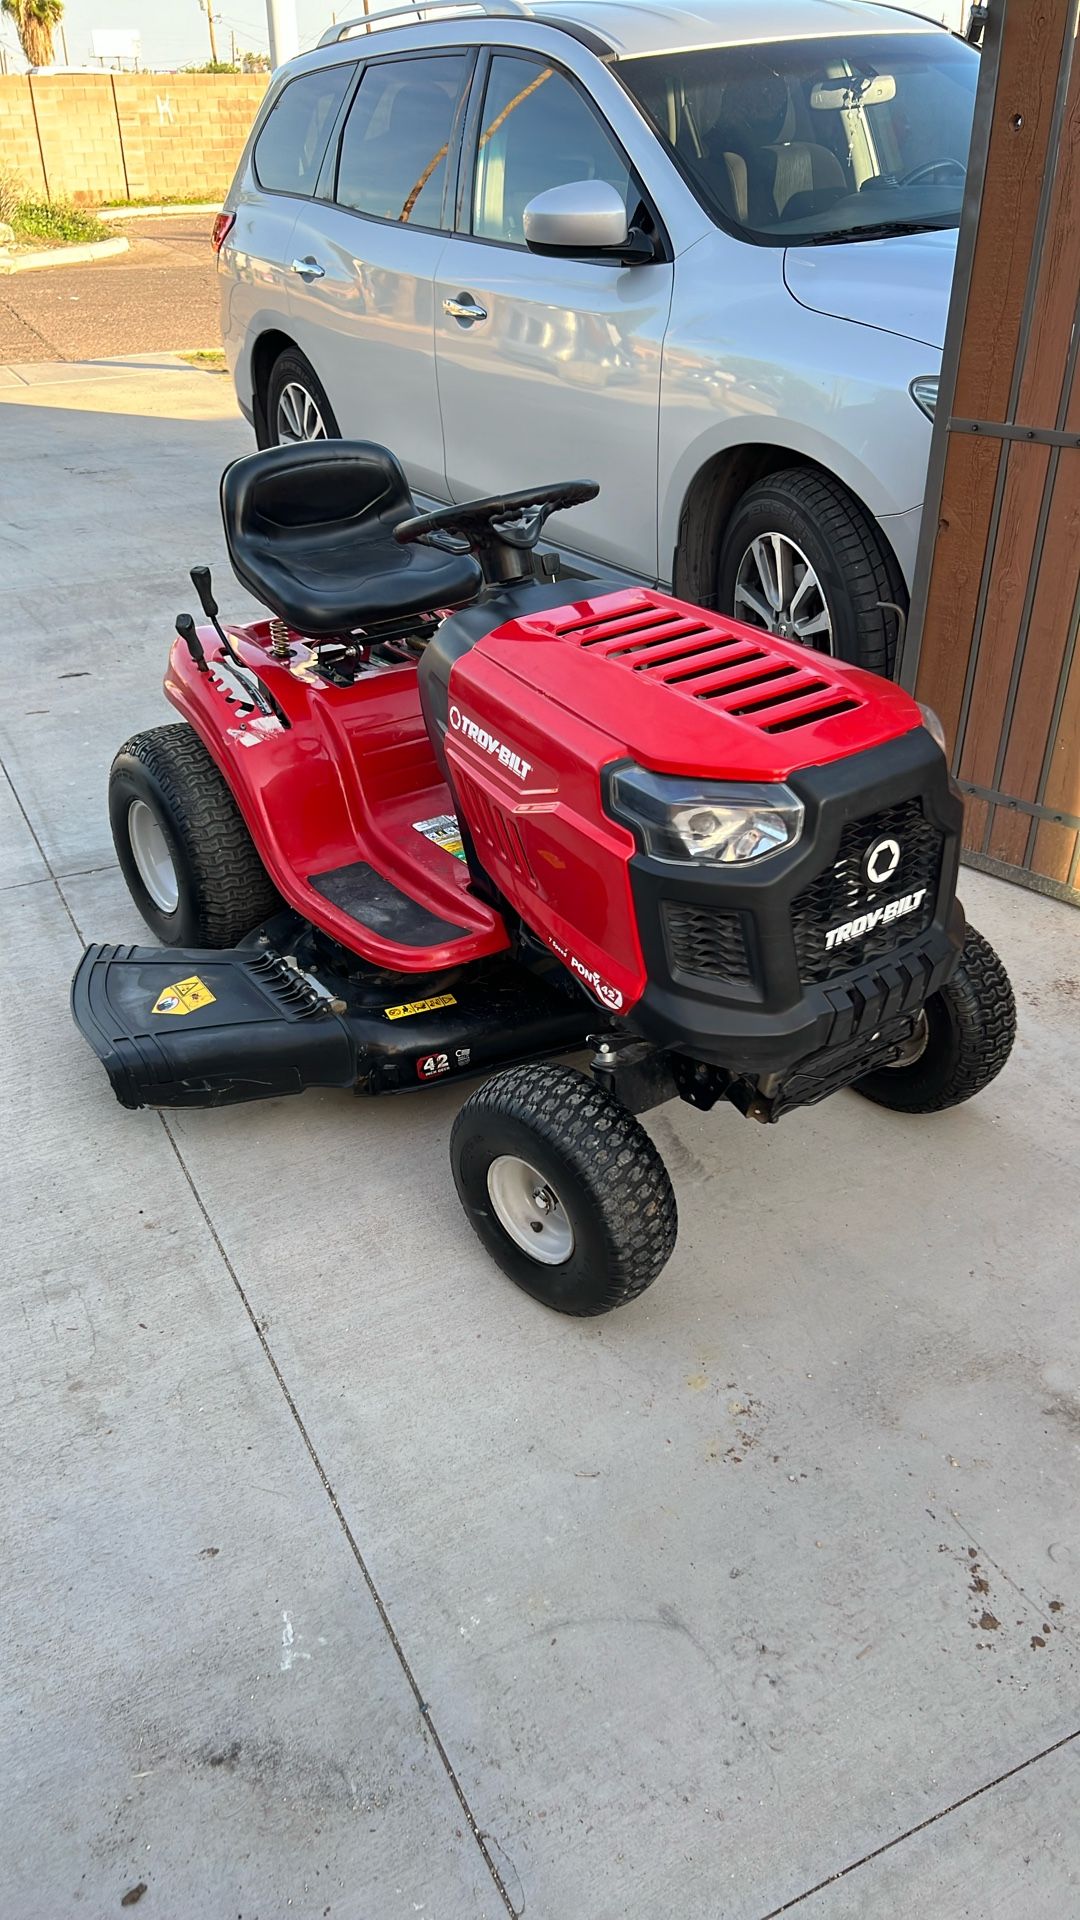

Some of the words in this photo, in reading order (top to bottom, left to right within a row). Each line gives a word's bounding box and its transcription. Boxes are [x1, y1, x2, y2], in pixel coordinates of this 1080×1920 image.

[462, 715, 532, 781] TROY-BILT
[825, 888, 927, 951] TROY-BILT
[571, 957, 600, 986] PONY
[601, 985, 615, 1001] 42
[423, 1054, 449, 1070] 42
